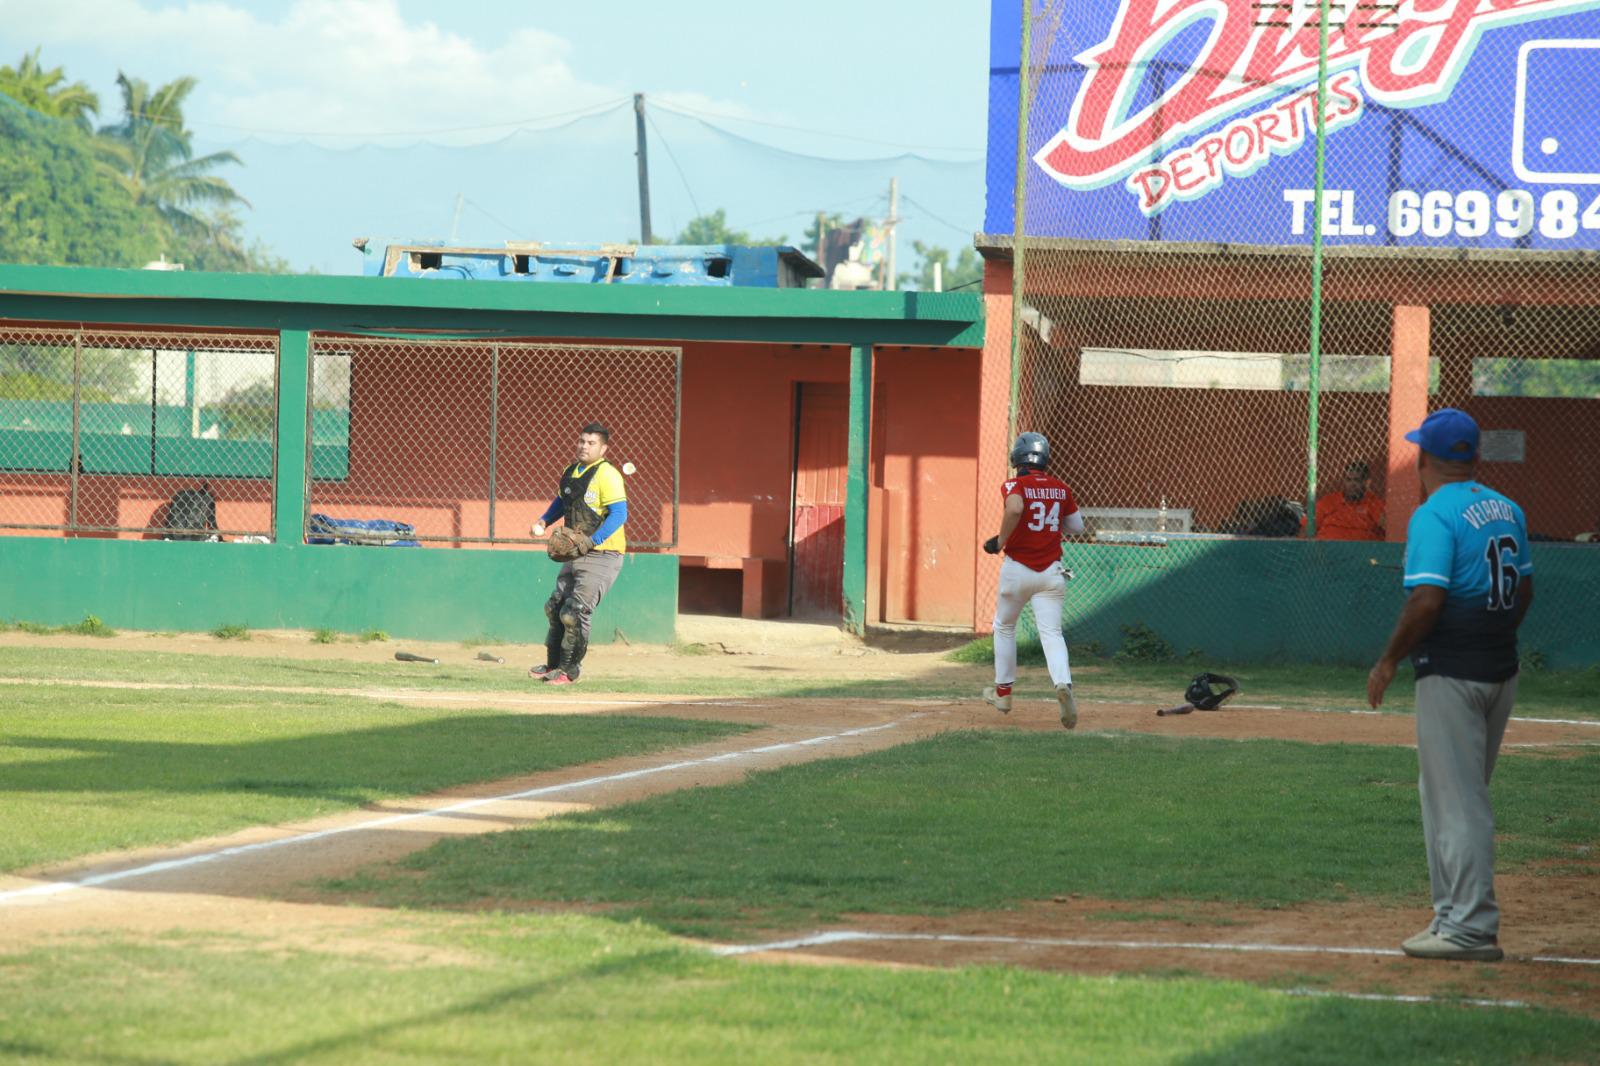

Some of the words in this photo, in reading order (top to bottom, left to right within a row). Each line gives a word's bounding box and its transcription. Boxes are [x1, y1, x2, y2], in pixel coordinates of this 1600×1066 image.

[1132, 75, 1361, 208] DEPORTES
[1283, 189, 1376, 235] TEL.
[1024, 487, 1066, 500] VALENZUELA
[1027, 501, 1060, 532] 34
[1484, 534, 1520, 611] 16
